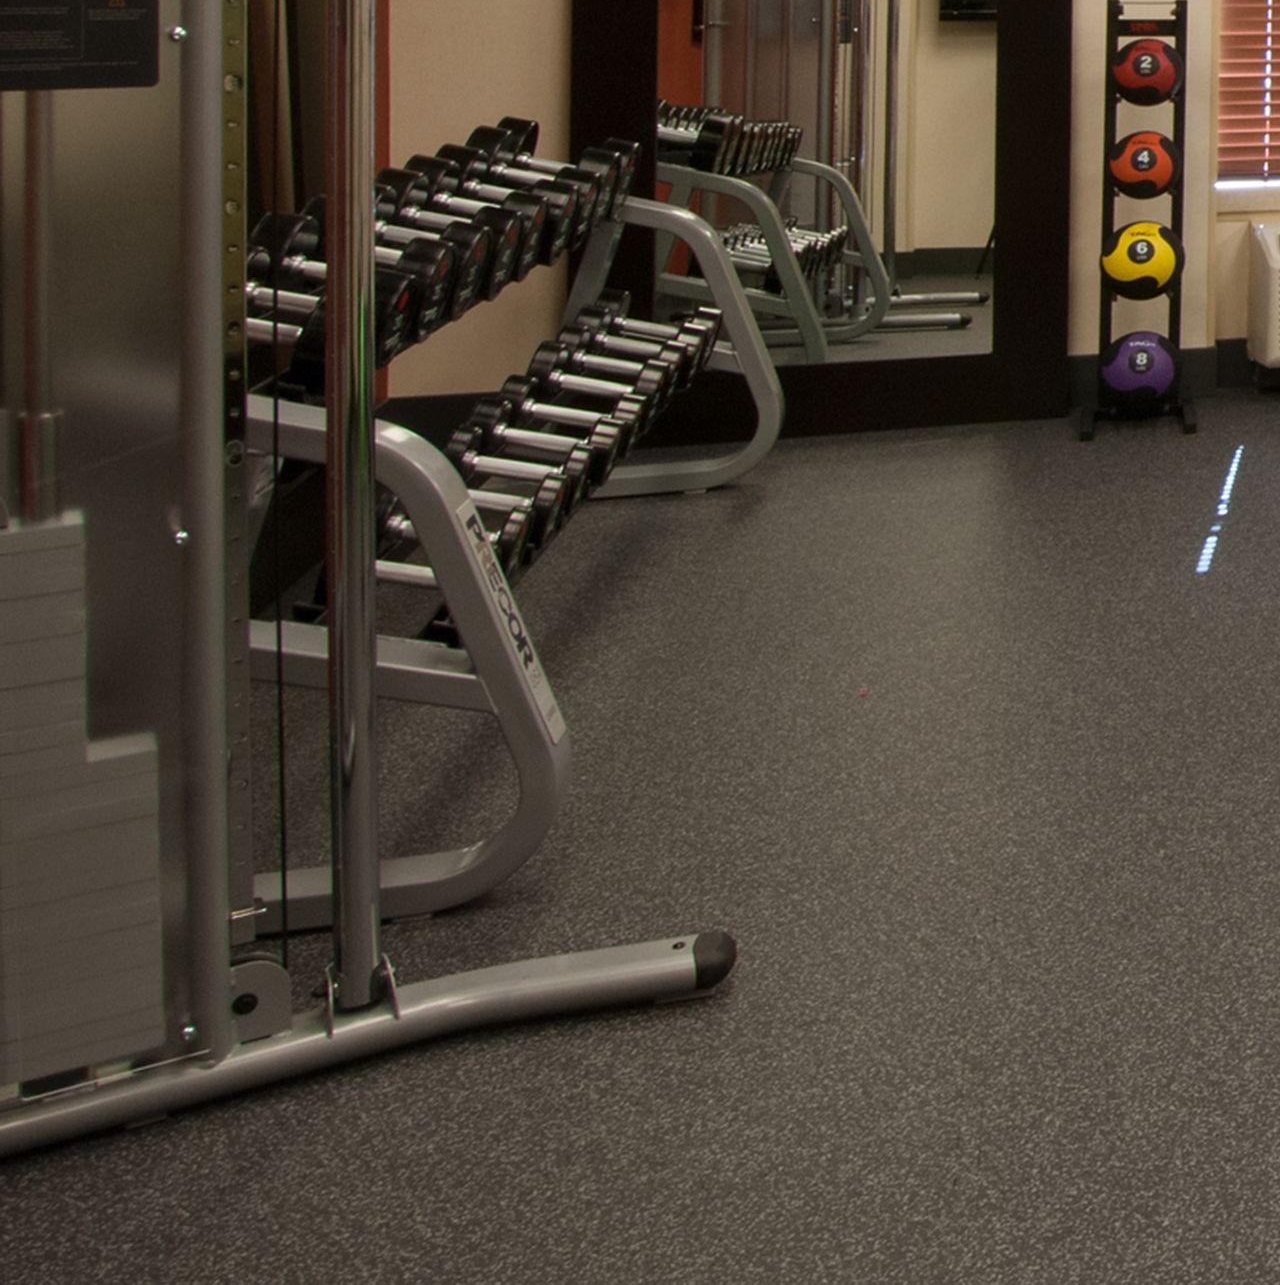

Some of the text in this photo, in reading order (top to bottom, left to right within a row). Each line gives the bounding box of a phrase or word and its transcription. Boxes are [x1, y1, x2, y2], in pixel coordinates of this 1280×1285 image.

[1139, 55, 1153, 69] 2
[1136, 150, 1150, 164] 4
[1135, 241, 1149, 255] 6
[1135, 352, 1148, 366] 8
[464, 513, 535, 670] PRECOR
